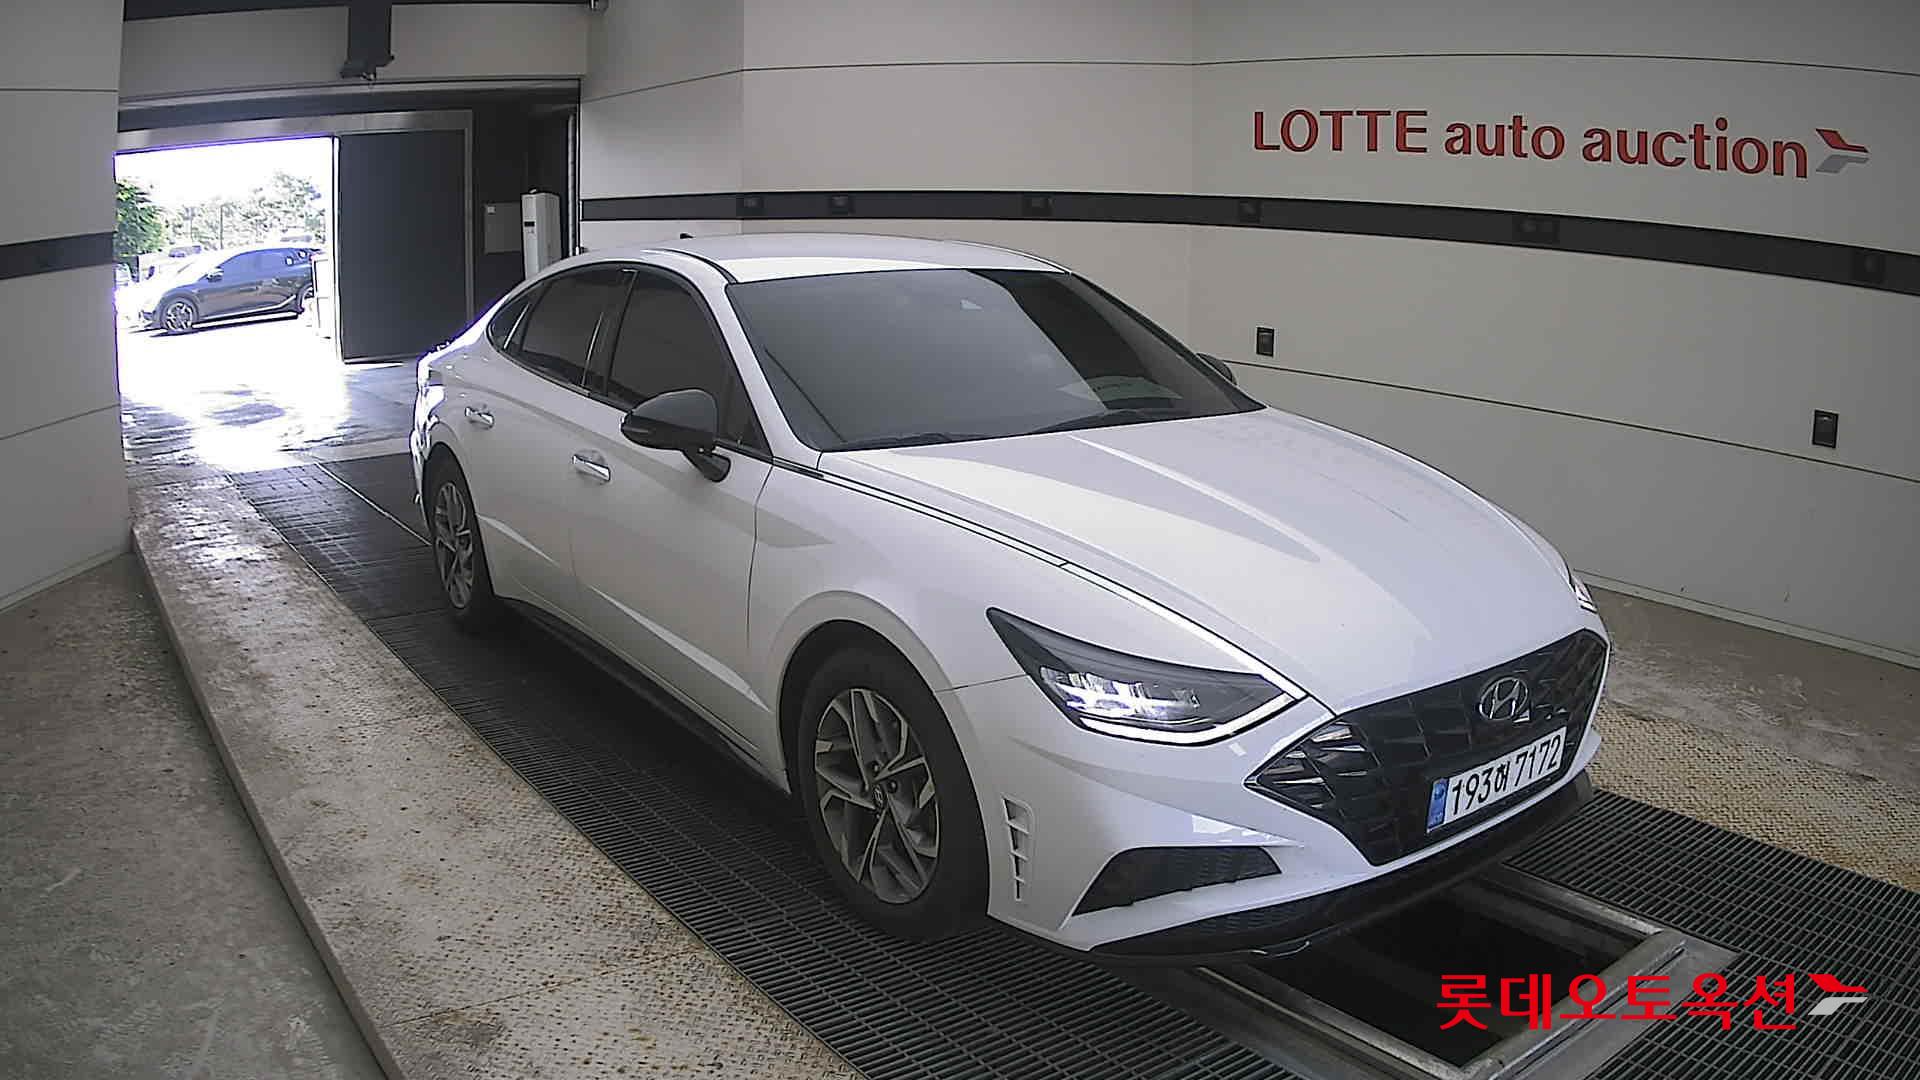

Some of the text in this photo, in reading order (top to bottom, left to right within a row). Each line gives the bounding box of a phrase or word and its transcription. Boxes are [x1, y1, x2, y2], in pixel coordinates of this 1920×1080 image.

[1253, 109, 1807, 178] LOTTE auto auction
[1514, 734, 1561, 787] 7172
